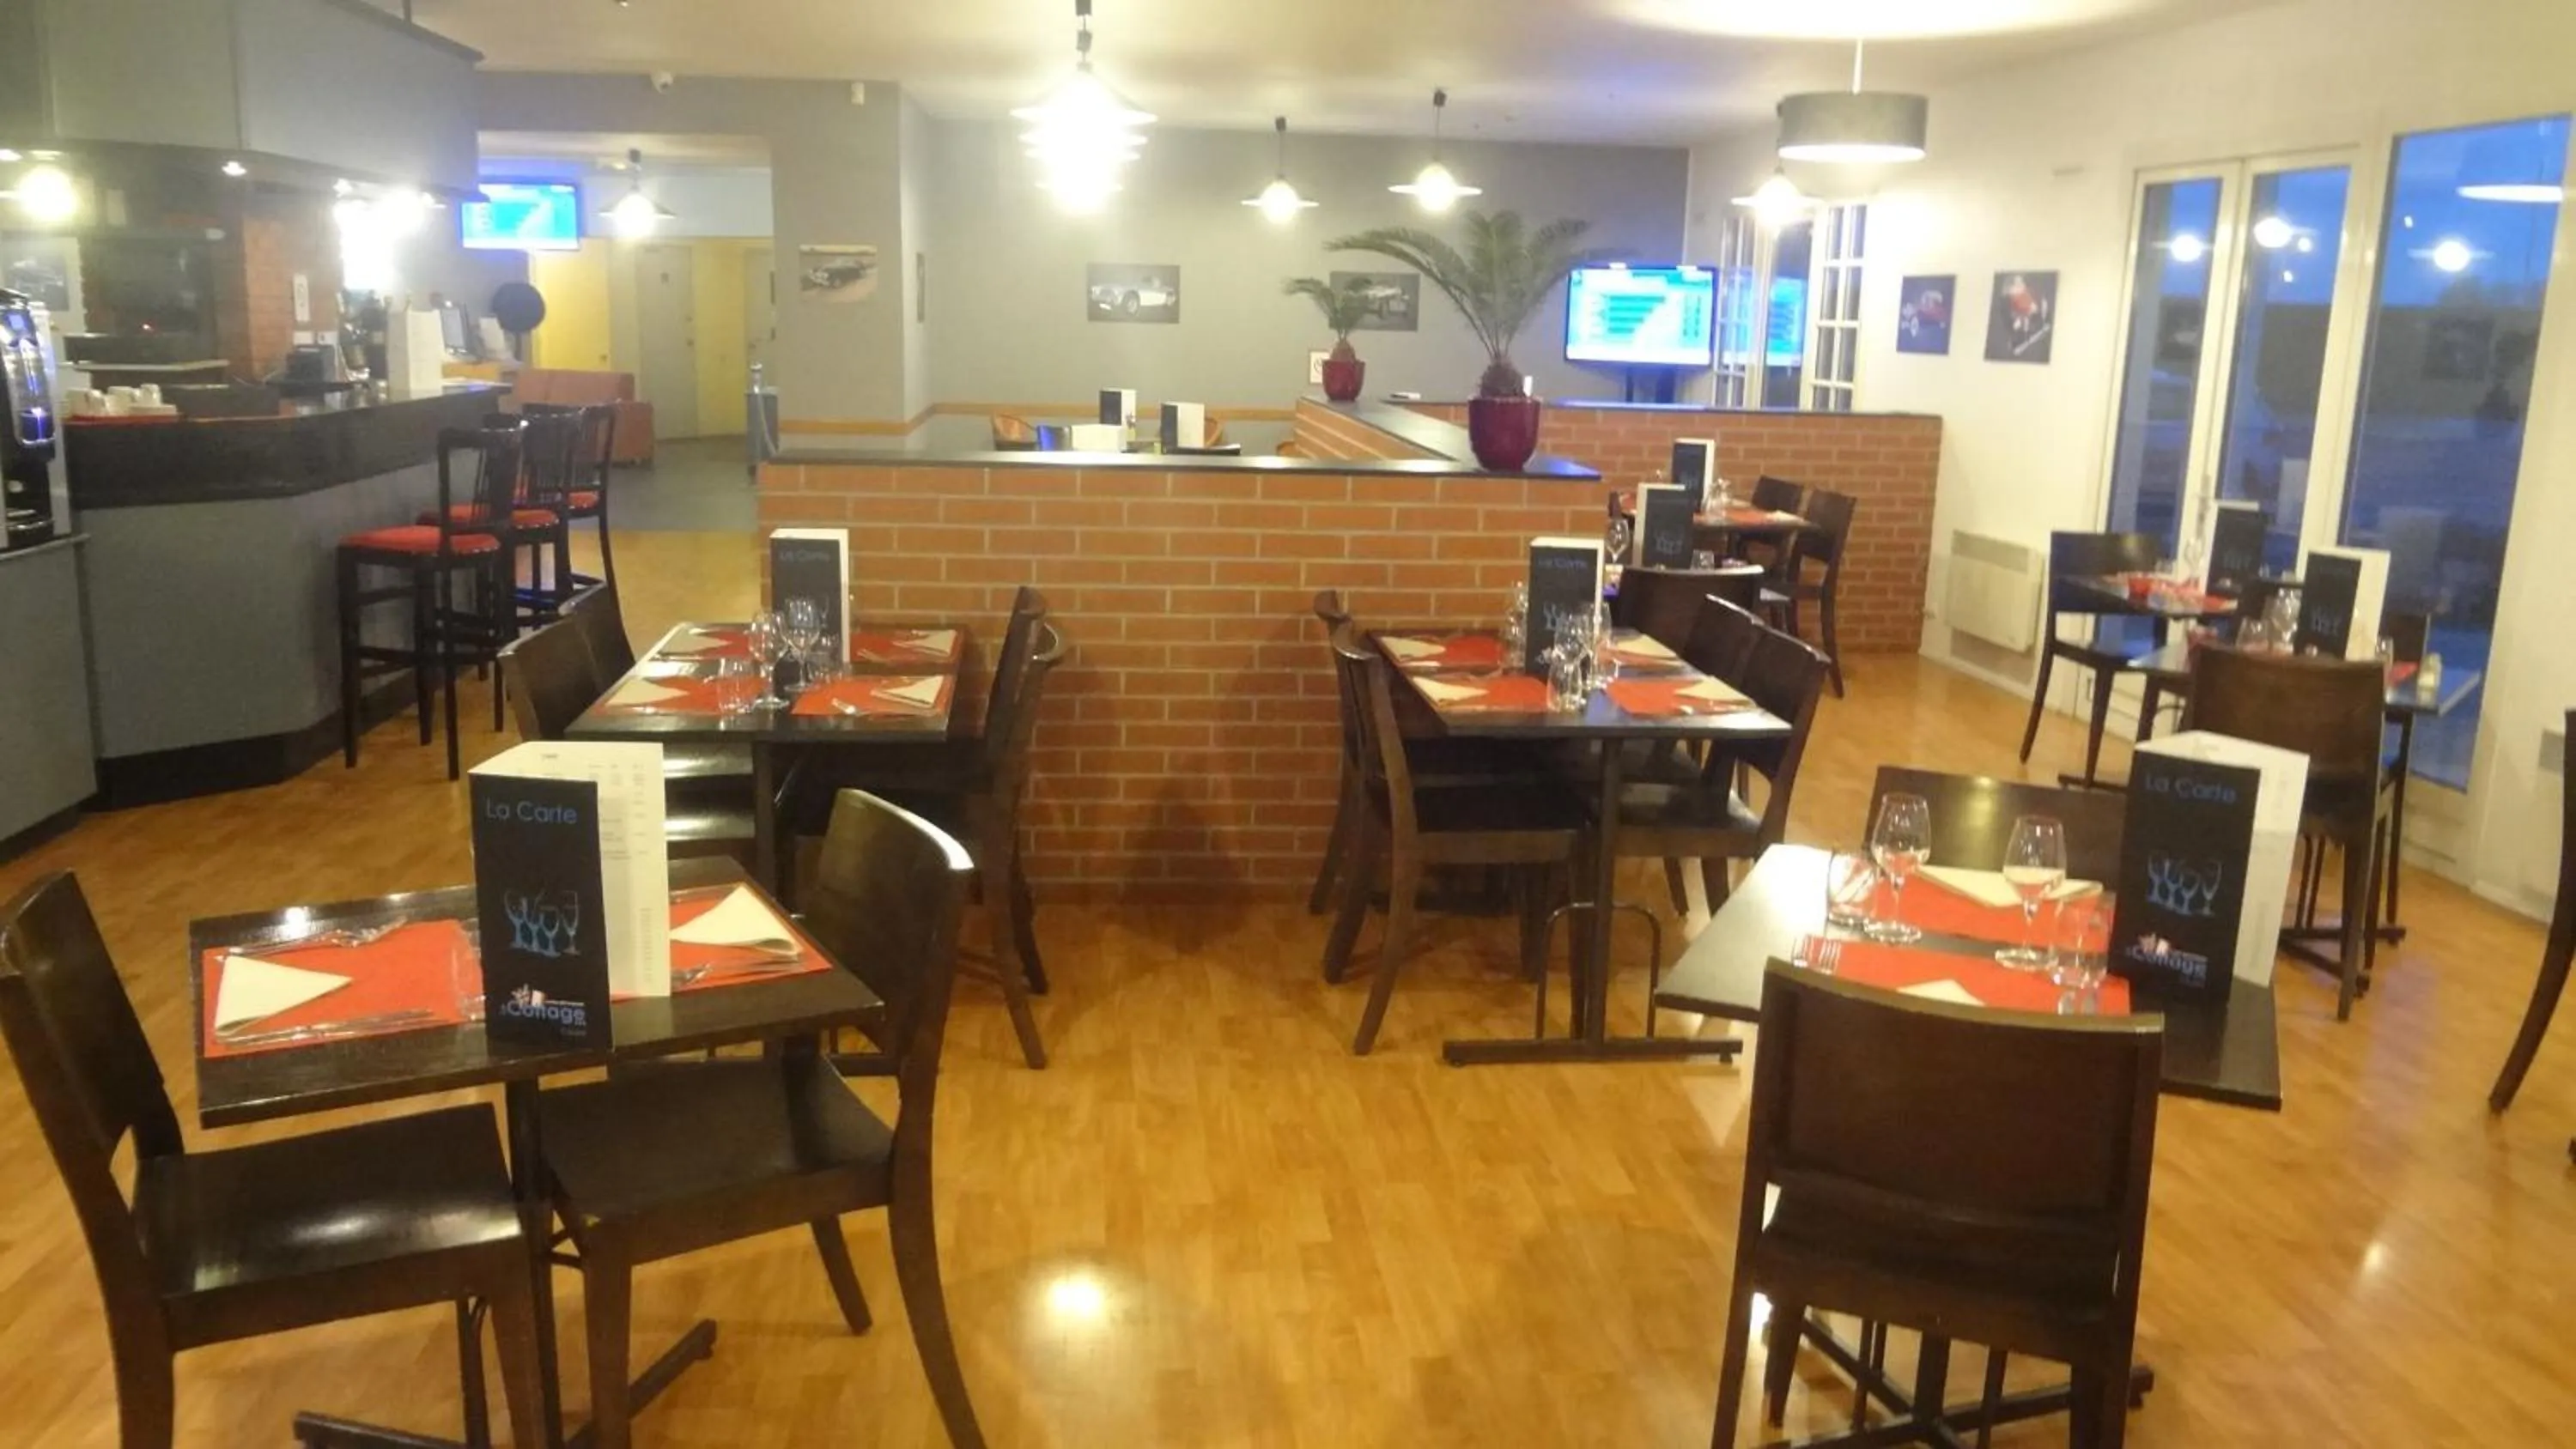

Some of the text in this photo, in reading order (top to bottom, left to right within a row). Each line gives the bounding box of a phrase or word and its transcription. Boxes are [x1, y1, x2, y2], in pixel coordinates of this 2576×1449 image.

[2145, 773, 2238, 804] La Carte
[485, 796, 578, 825] La Carte
